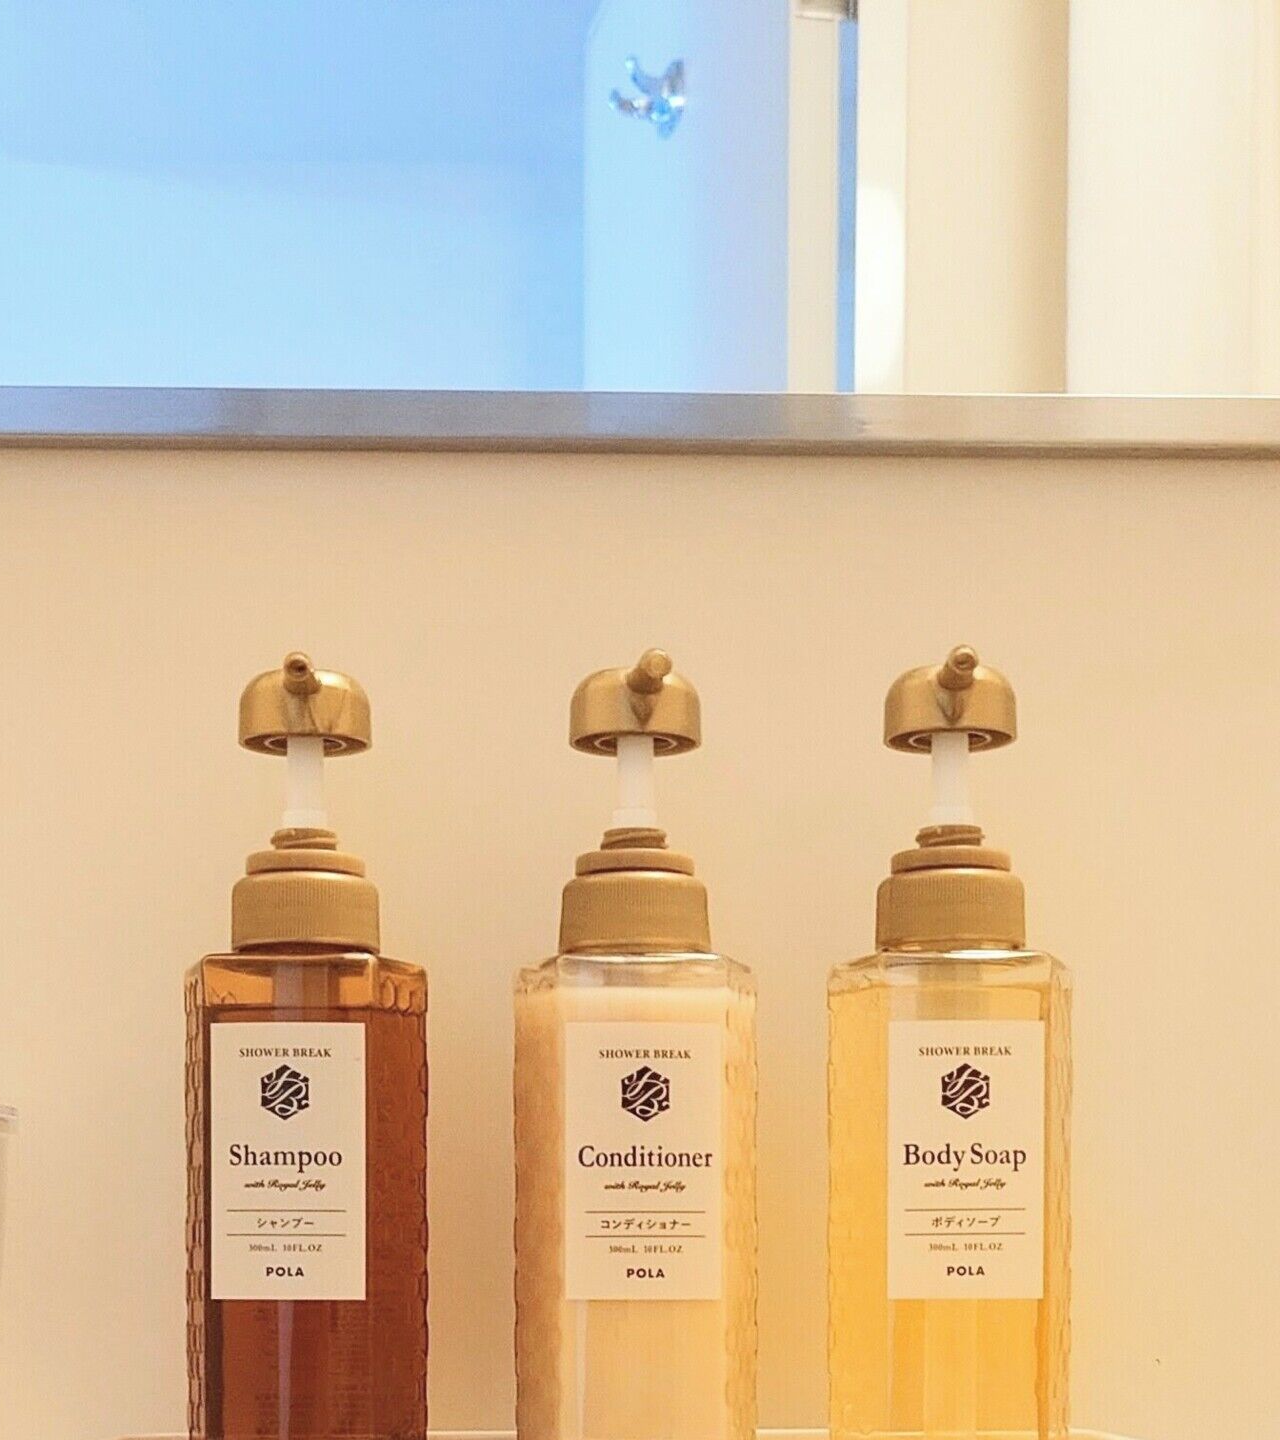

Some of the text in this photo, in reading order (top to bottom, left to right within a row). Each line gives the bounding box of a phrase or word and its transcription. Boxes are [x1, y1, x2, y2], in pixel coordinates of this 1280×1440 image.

[239, 1047, 332, 1058] SHOWER BREAK
[598, 1049, 692, 1059] SHOWER BREAK
[918, 1046, 1013, 1057] SHOWER BREAK
[229, 1143, 343, 1174] Shampoo
[578, 1145, 713, 1168] Conditioner
[903, 1142, 1027, 1172] Body Soap
[243, 1179, 266, 1189] with
[600, 1218, 692, 1230] コンディショナー
[265, 1266, 305, 1278] POLA
[626, 1267, 666, 1279] POLA
[946, 1265, 986, 1277] POLA
